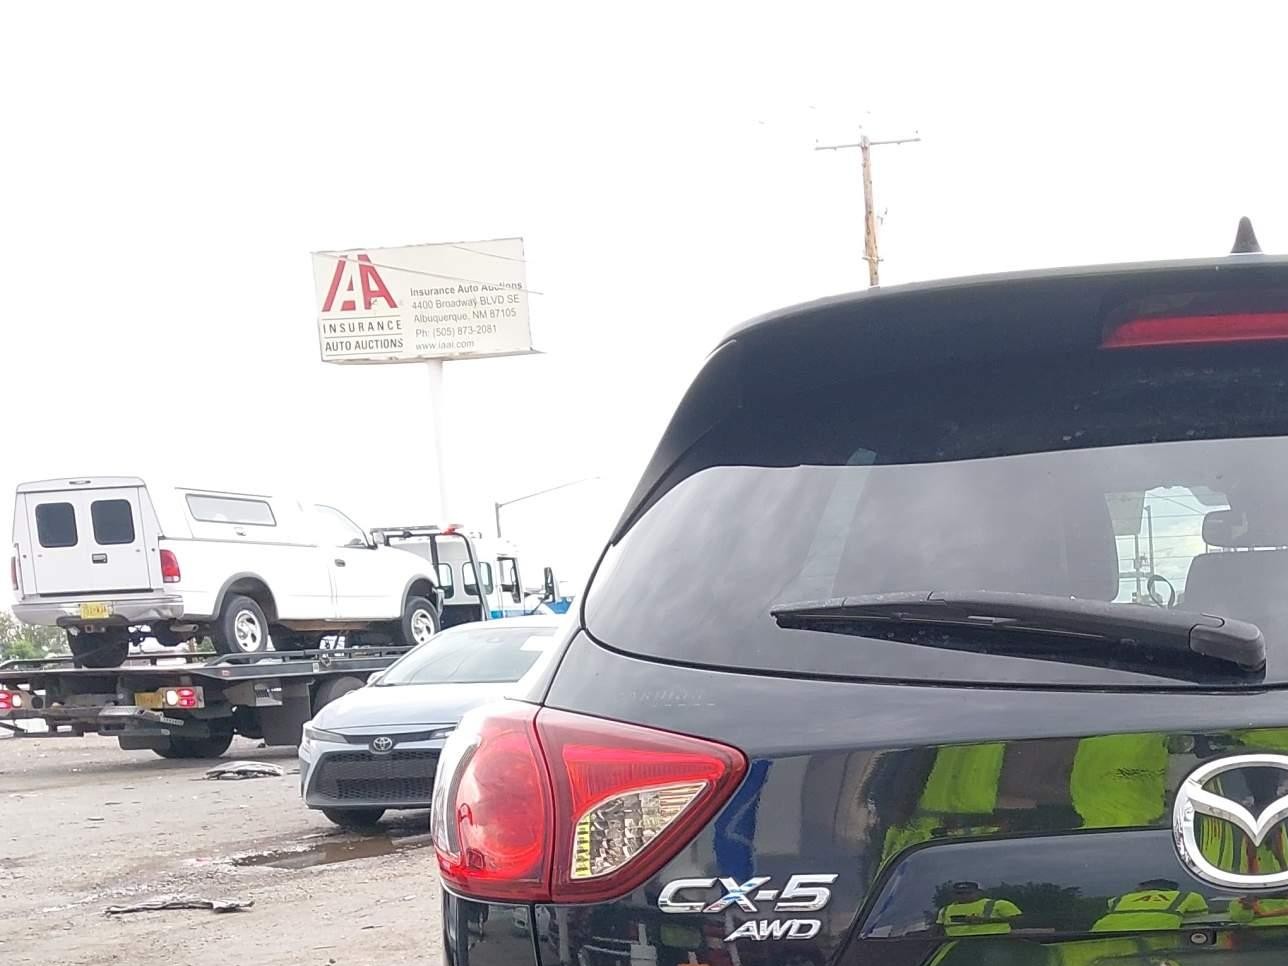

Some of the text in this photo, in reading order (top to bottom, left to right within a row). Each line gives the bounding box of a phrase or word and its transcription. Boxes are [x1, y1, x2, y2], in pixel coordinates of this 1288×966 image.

[410, 286, 455, 297] Insurance
[457, 284, 479, 293] Auto
[412, 294, 520, 310] 4400 Broadway BLVD SE
[472, 309, 488, 319] NM
[489, 307, 517, 318] 87105
[322, 319, 402, 334] INSURANCE
[432, 327, 455, 338] (505)
[457, 324, 497, 336] 873-2081
[325, 338, 404, 352] AUTO AUCTIONS
[657, 873, 839, 914] CX-5
[723, 918, 822, 942] AWD
